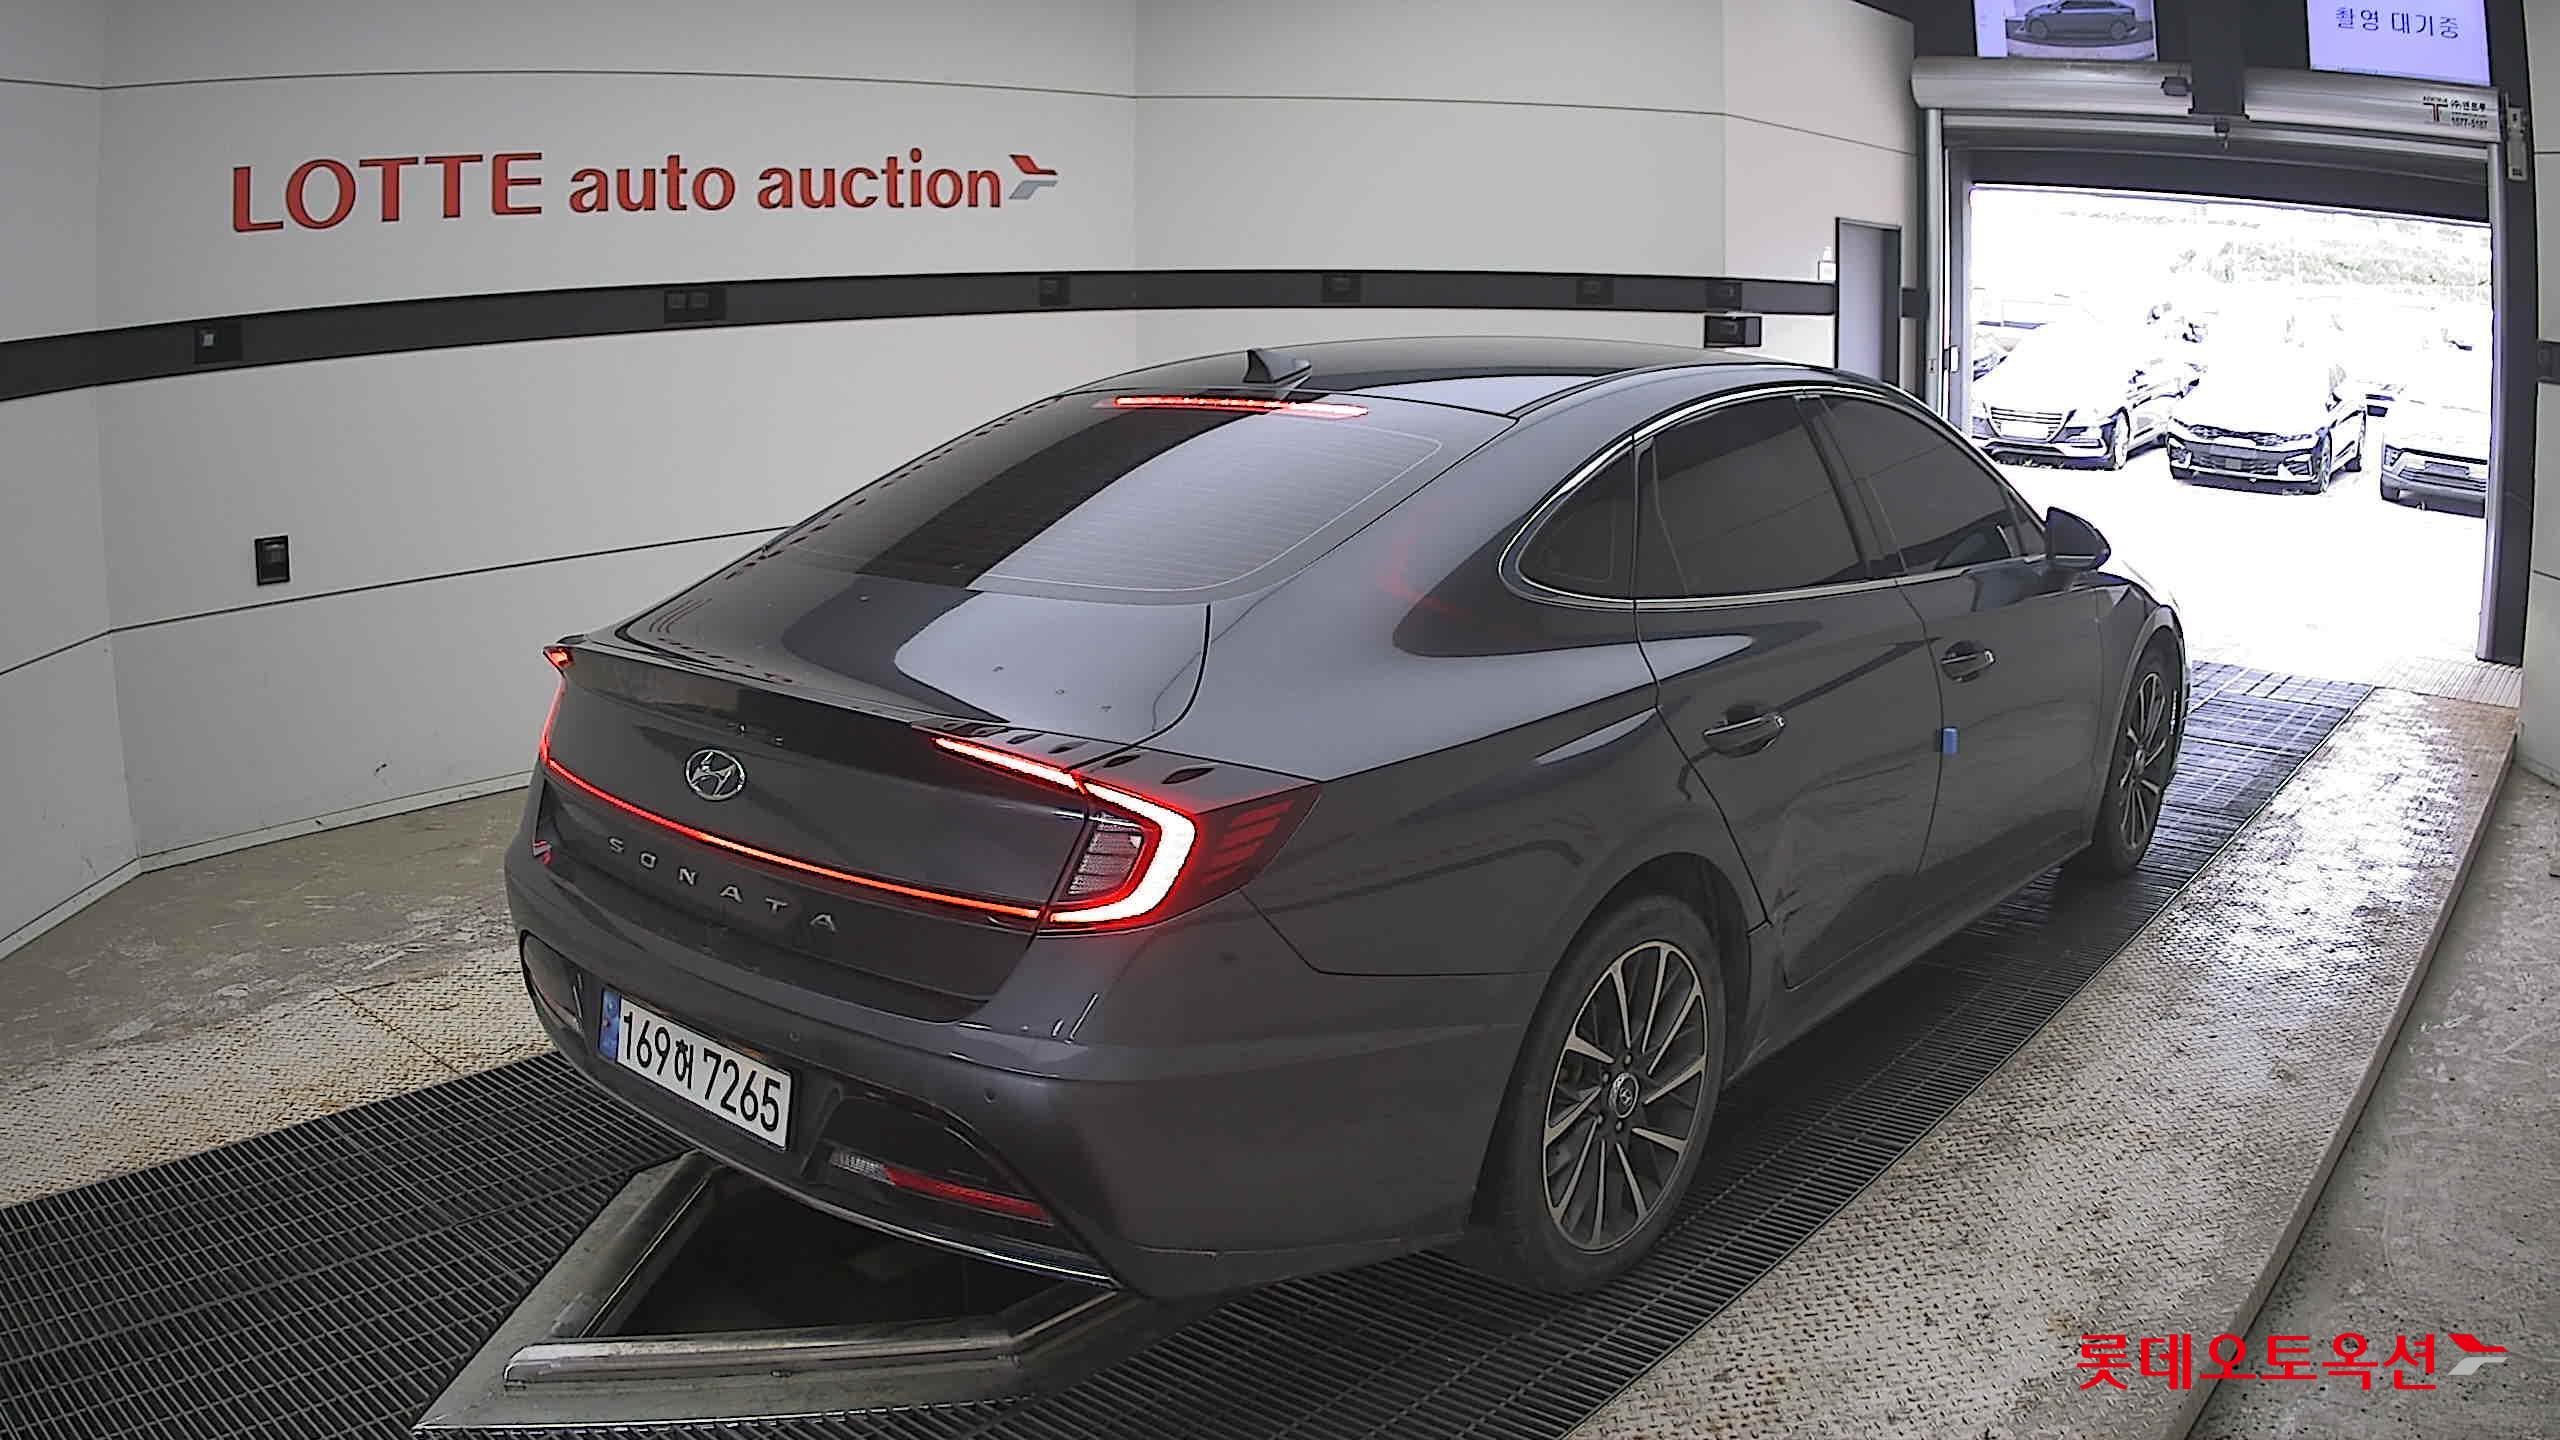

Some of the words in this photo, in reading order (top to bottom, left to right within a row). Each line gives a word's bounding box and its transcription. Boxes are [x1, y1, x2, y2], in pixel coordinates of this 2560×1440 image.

[2336, 7, 2379, 31] 촬영
[2391, 12, 2458, 39] 대기중
[233, 152, 544, 233] LOTTE
[569, 154, 737, 214] auto
[758, 148, 1003, 209] auction
[608, 837, 837, 932] SONATA
[623, 1011, 694, 1090] 169허
[703, 1047, 780, 1132] 7265
